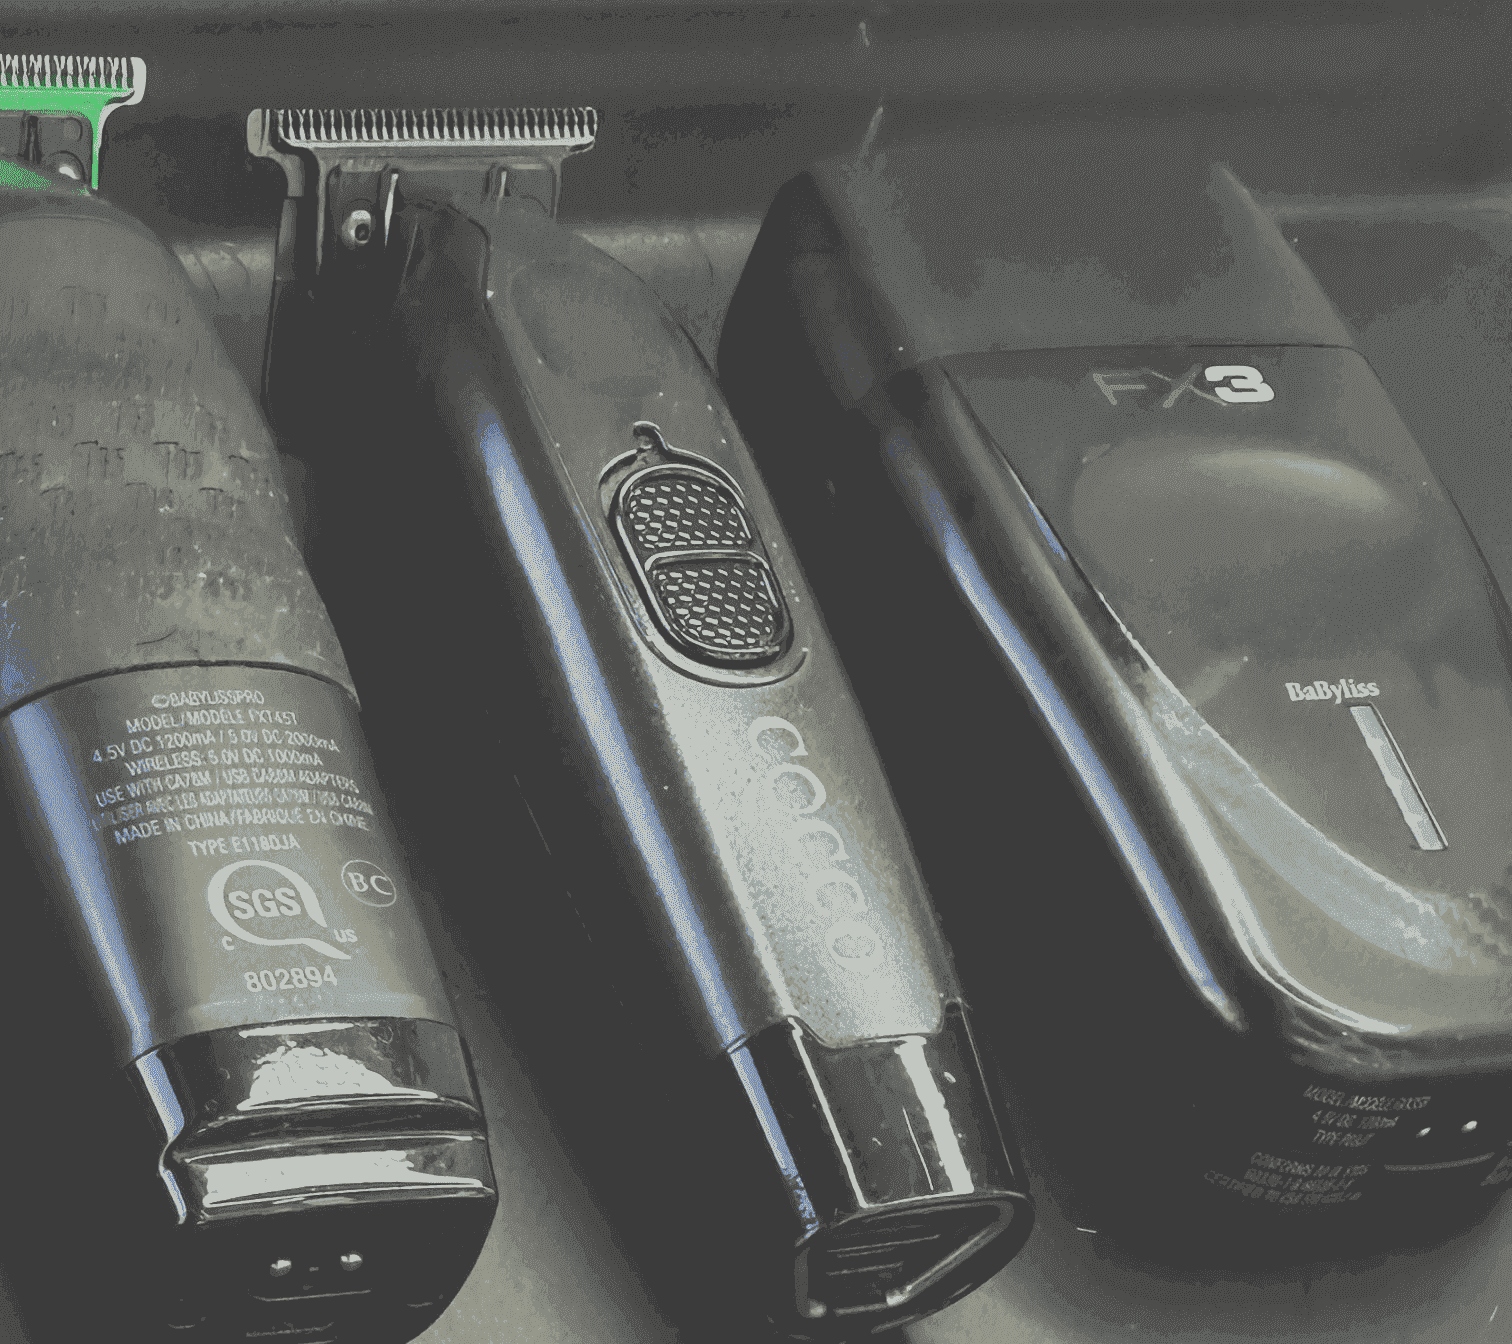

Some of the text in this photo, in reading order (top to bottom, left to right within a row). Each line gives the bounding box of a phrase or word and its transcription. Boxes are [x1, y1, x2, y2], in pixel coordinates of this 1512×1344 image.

[1285, 678, 1381, 706] BaByliss
[130, 736, 154, 755] DC
[261, 728, 284, 745] DC
[242, 747, 265, 764] DC
[95, 785, 126, 808] USE
[125, 777, 164, 798] WITH
[114, 818, 163, 845] MADE
[163, 816, 183, 833] IN
[187, 836, 229, 857] TYPE
[228, 886, 302, 920] SGS
[244, 964, 338, 993] 802894
